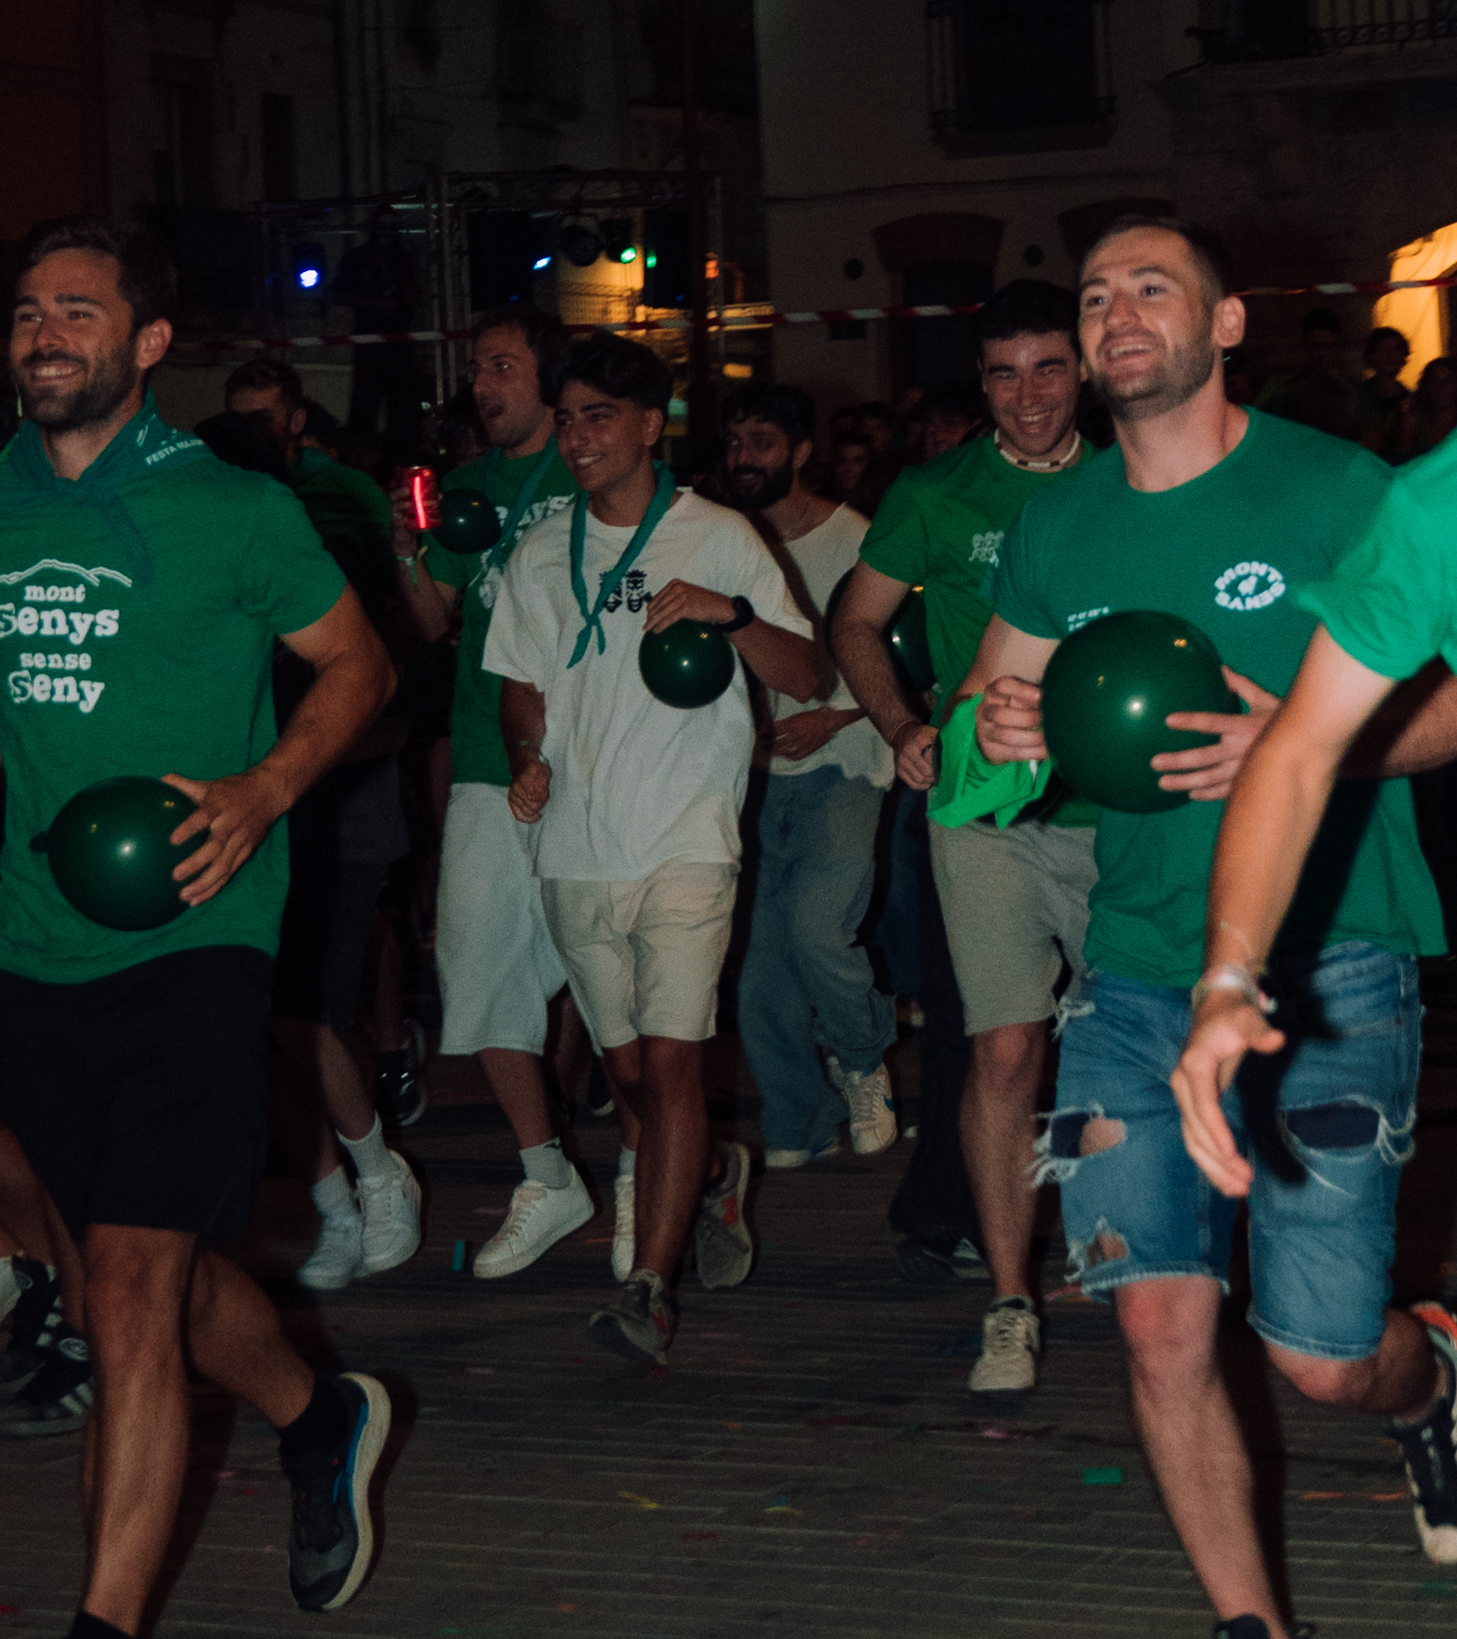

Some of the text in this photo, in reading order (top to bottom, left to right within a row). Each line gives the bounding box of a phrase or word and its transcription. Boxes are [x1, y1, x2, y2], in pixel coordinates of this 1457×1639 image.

[24, 584, 86, 603] mont
[20, 652, 92, 670] sense
[8, 669, 105, 714] Seny
